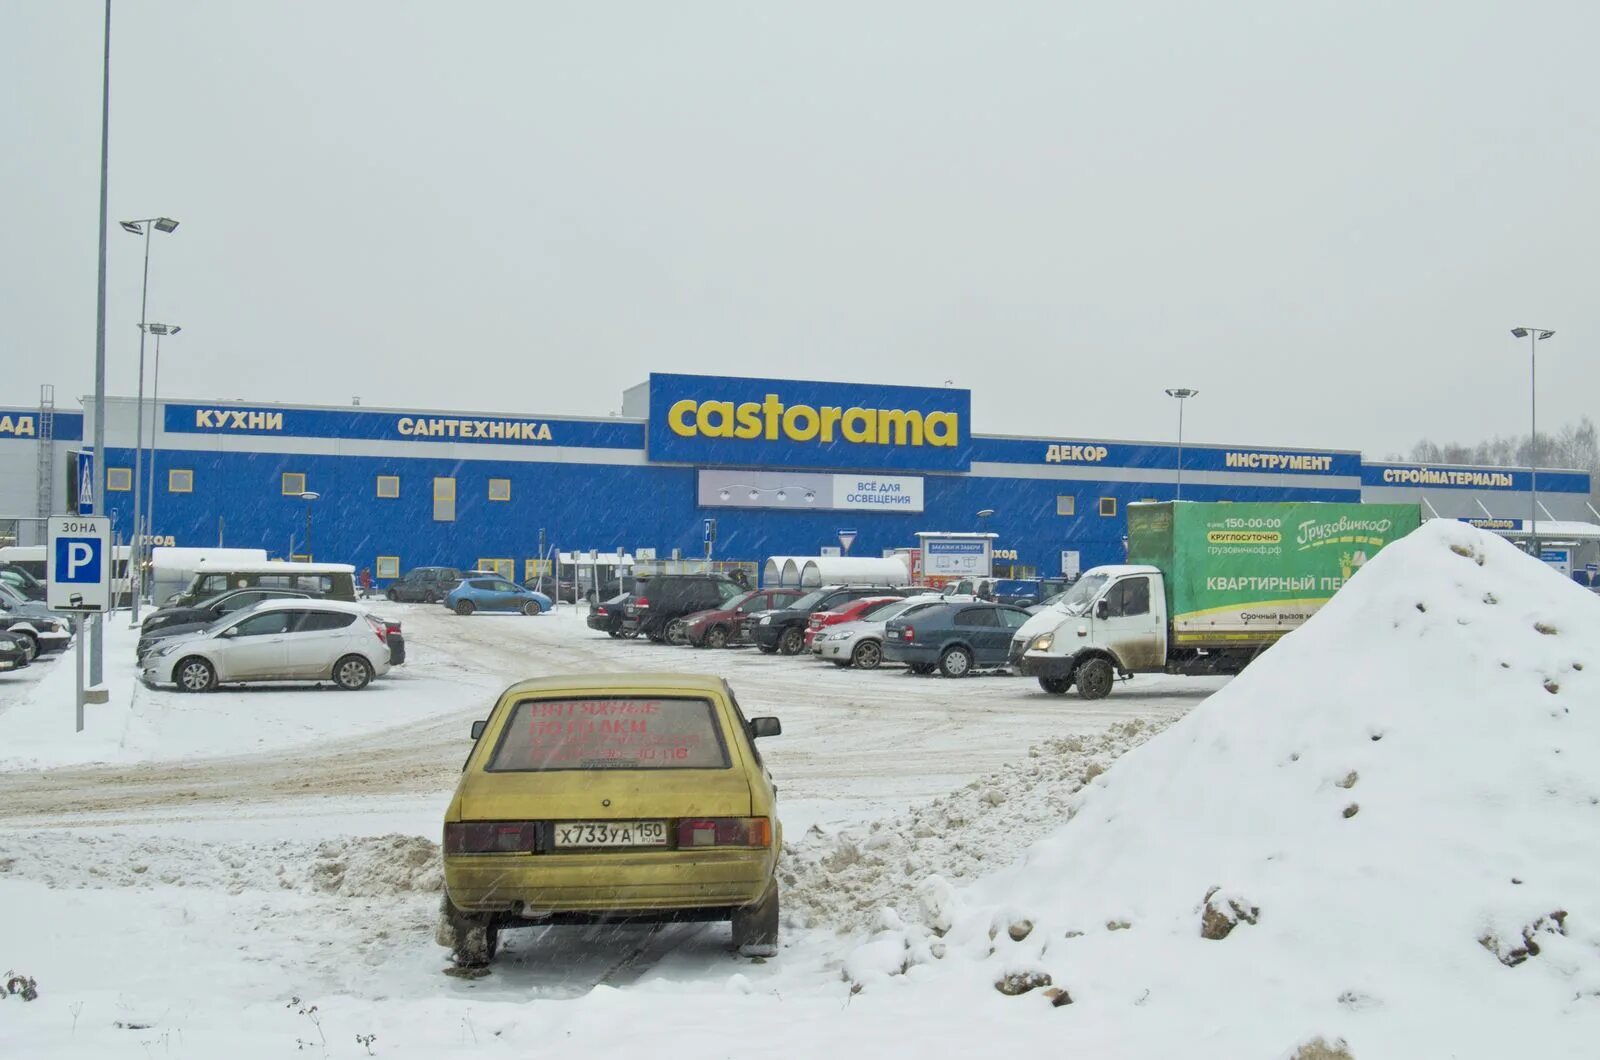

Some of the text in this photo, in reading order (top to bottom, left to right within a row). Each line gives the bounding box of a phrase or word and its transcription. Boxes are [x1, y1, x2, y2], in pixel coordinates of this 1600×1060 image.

[195, 409, 284, 431] КУХНИ
[667, 393, 959, 447] castorama
[397, 417, 553, 442] САНТЕХНИКА
[1045, 444, 1108, 463] ДЕКОР
[1225, 453, 1333, 471] ИНСТРУМЕНТ
[1383, 467, 1513, 488] СТРОЙМАТЕРИАЛЫ
[857, 481, 901, 493] ВСЁ ДЛЯ
[847, 494, 911, 505] ОСВЕЩЕНИЯ
[62, 523, 97, 533] ЗОНА
[1225, 518, 1281, 528] 150-00-00
[1207, 546, 1281, 555] грузовичкоф.рф
[1206, 575, 1315, 591] КВАРТИРНЫЙ
[1240, 612, 1277, 621] Срочный
[635, 823, 662, 838] 150
